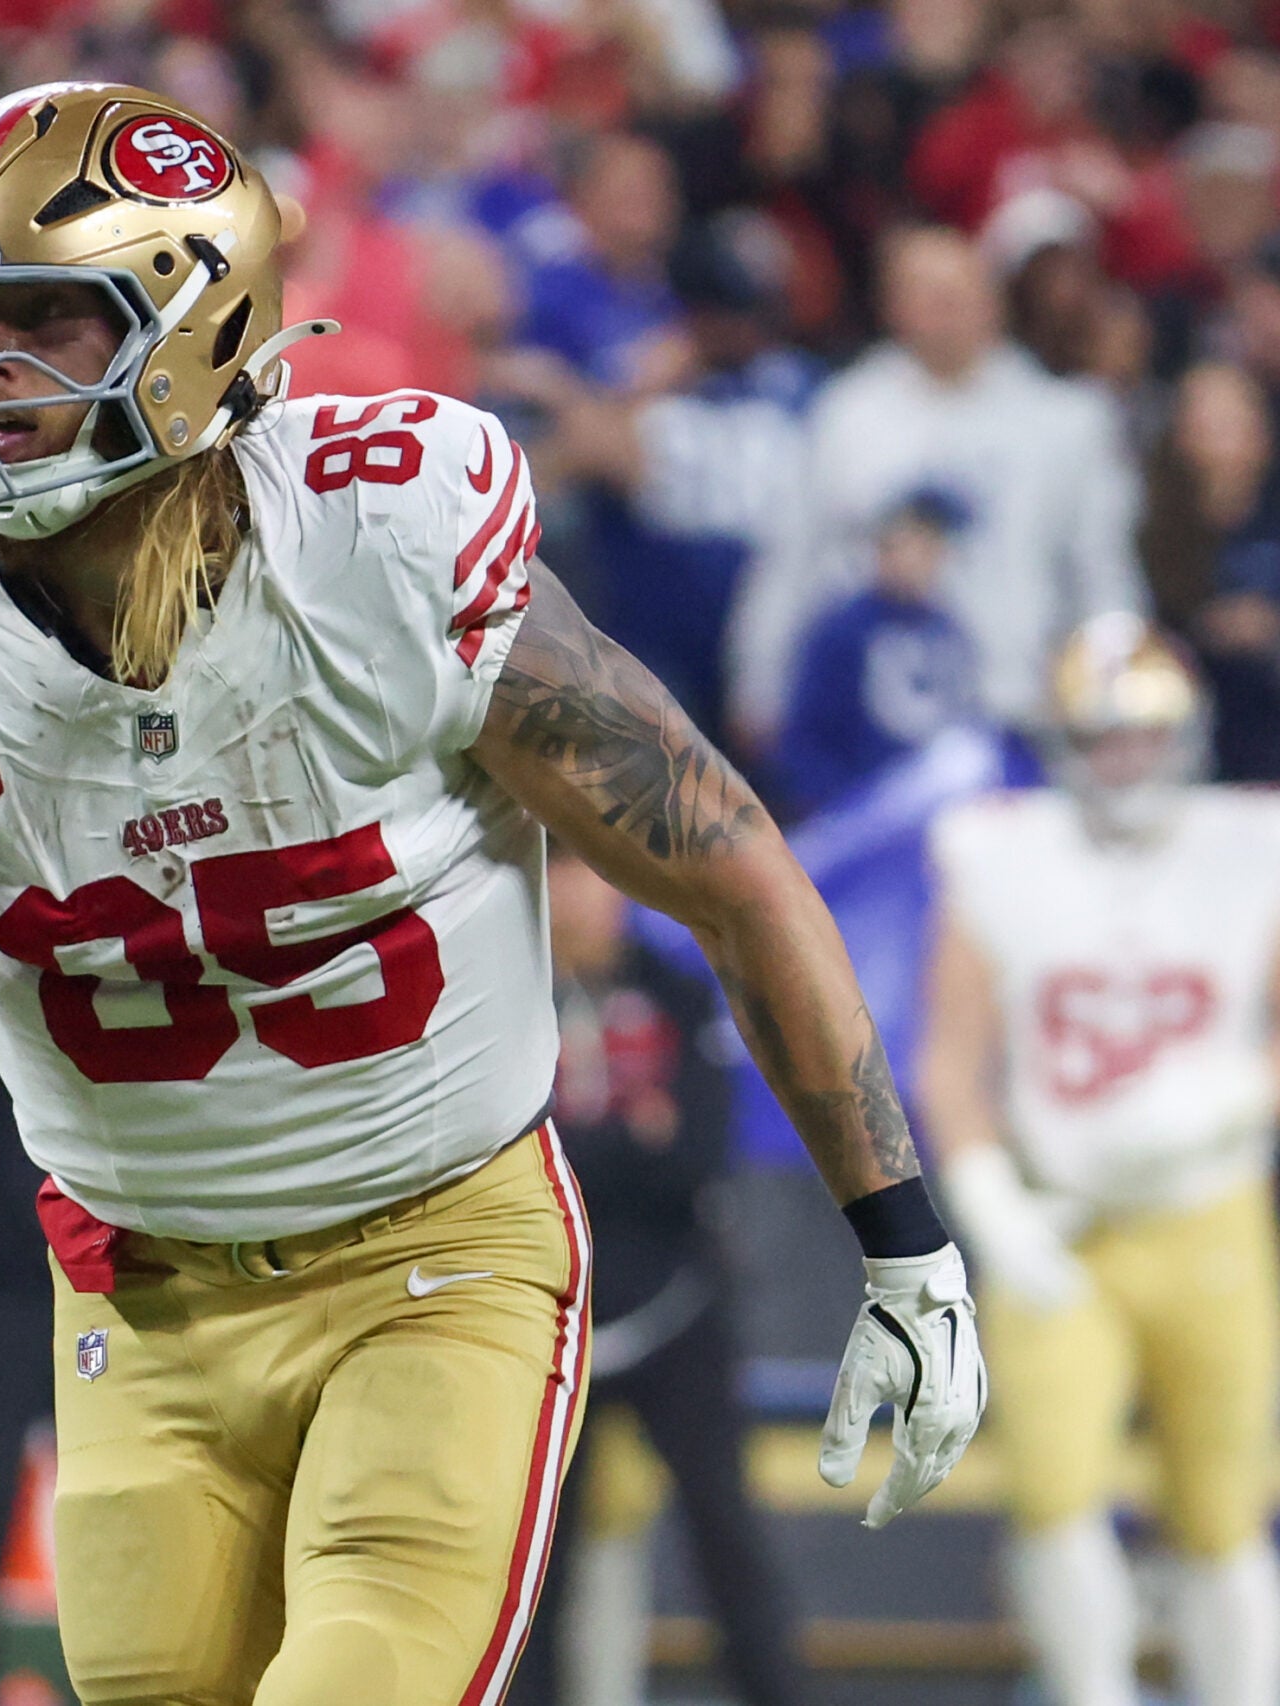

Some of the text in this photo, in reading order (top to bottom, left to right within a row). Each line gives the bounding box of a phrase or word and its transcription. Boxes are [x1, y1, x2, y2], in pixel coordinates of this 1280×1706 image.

[131, 121, 215, 192] SF
[304, 394, 439, 495] 85
[142, 730, 174, 752] NFL
[122, 797, 229, 857] 49ERS
[81, 1350, 101, 1371] NFL
